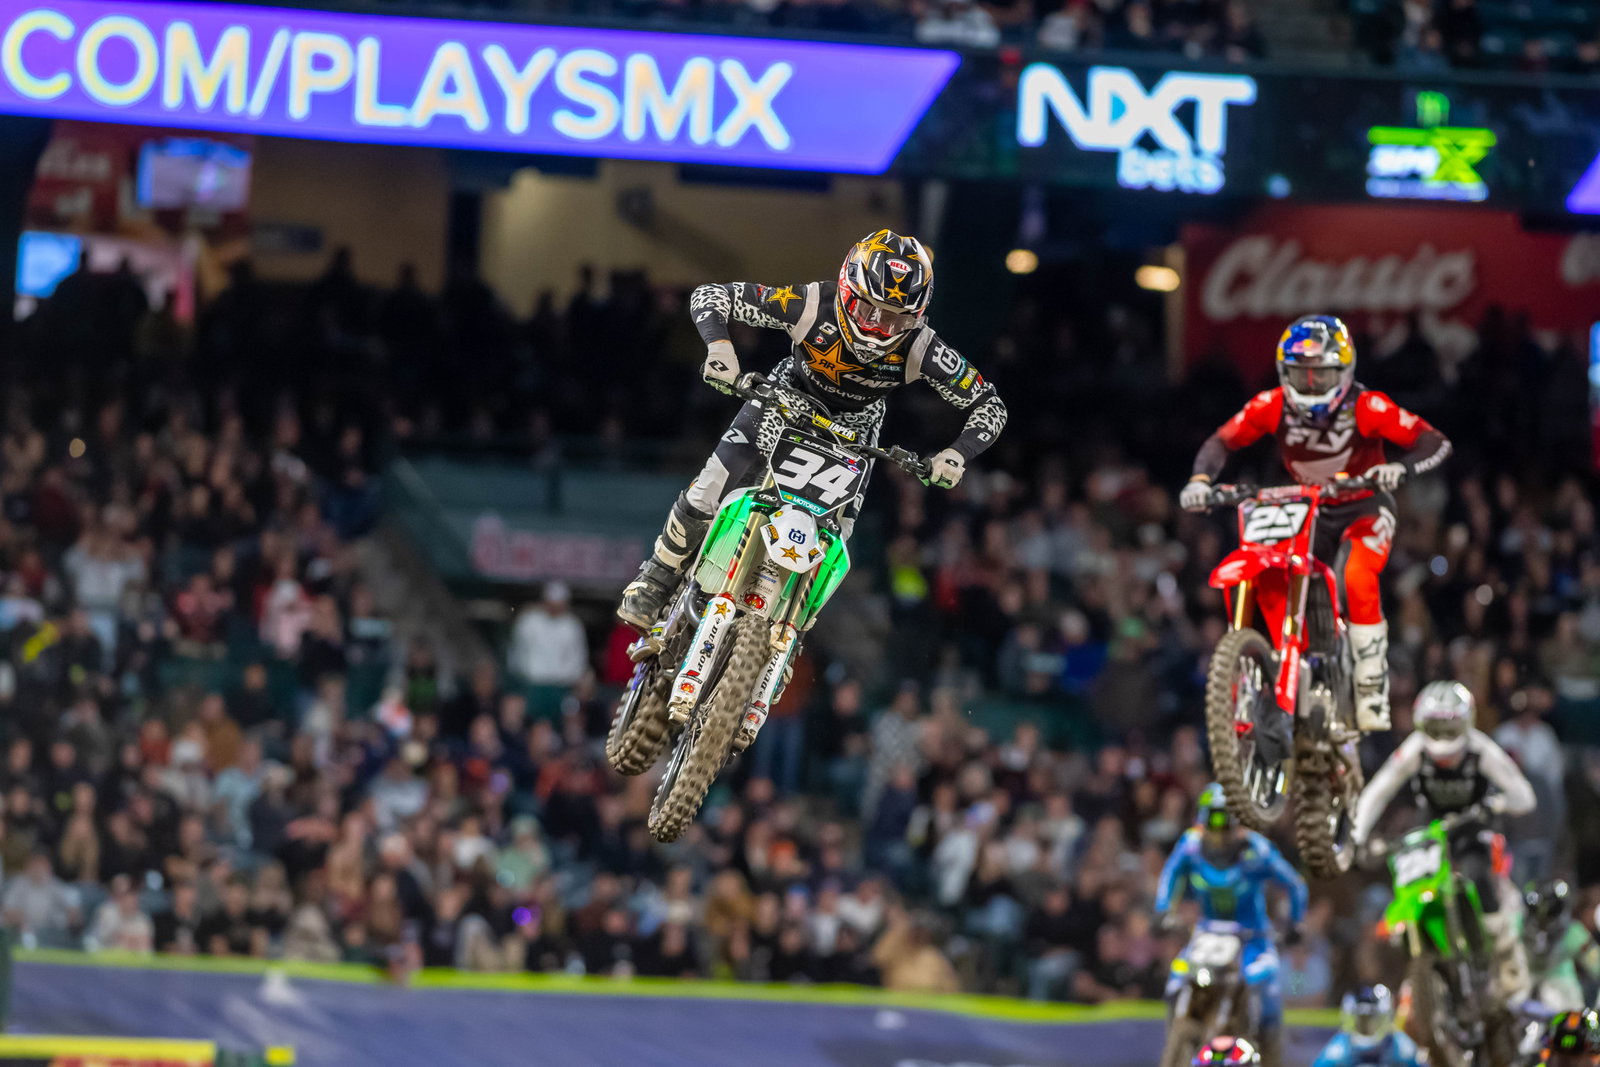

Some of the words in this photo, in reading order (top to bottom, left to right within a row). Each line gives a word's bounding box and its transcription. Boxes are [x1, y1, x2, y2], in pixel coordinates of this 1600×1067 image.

[1, 9, 793, 152] COM/PLAYSMX
[1017, 62, 1256, 154] NXT
[889, 261, 909, 272] BELL
[810, 375, 877, 401] Husqvar
[813, 412, 855, 440] PROTAPER
[1285, 426, 1354, 452] FLY
[803, 440, 844, 459] SUPERCROSS
[1413, 439, 1451, 474] HONDA
[773, 446, 858, 506] 34
[792, 496, 822, 514] MOTOREX
[697, 626, 719, 673] DUOP
[761, 651, 780, 692] DUNLO
